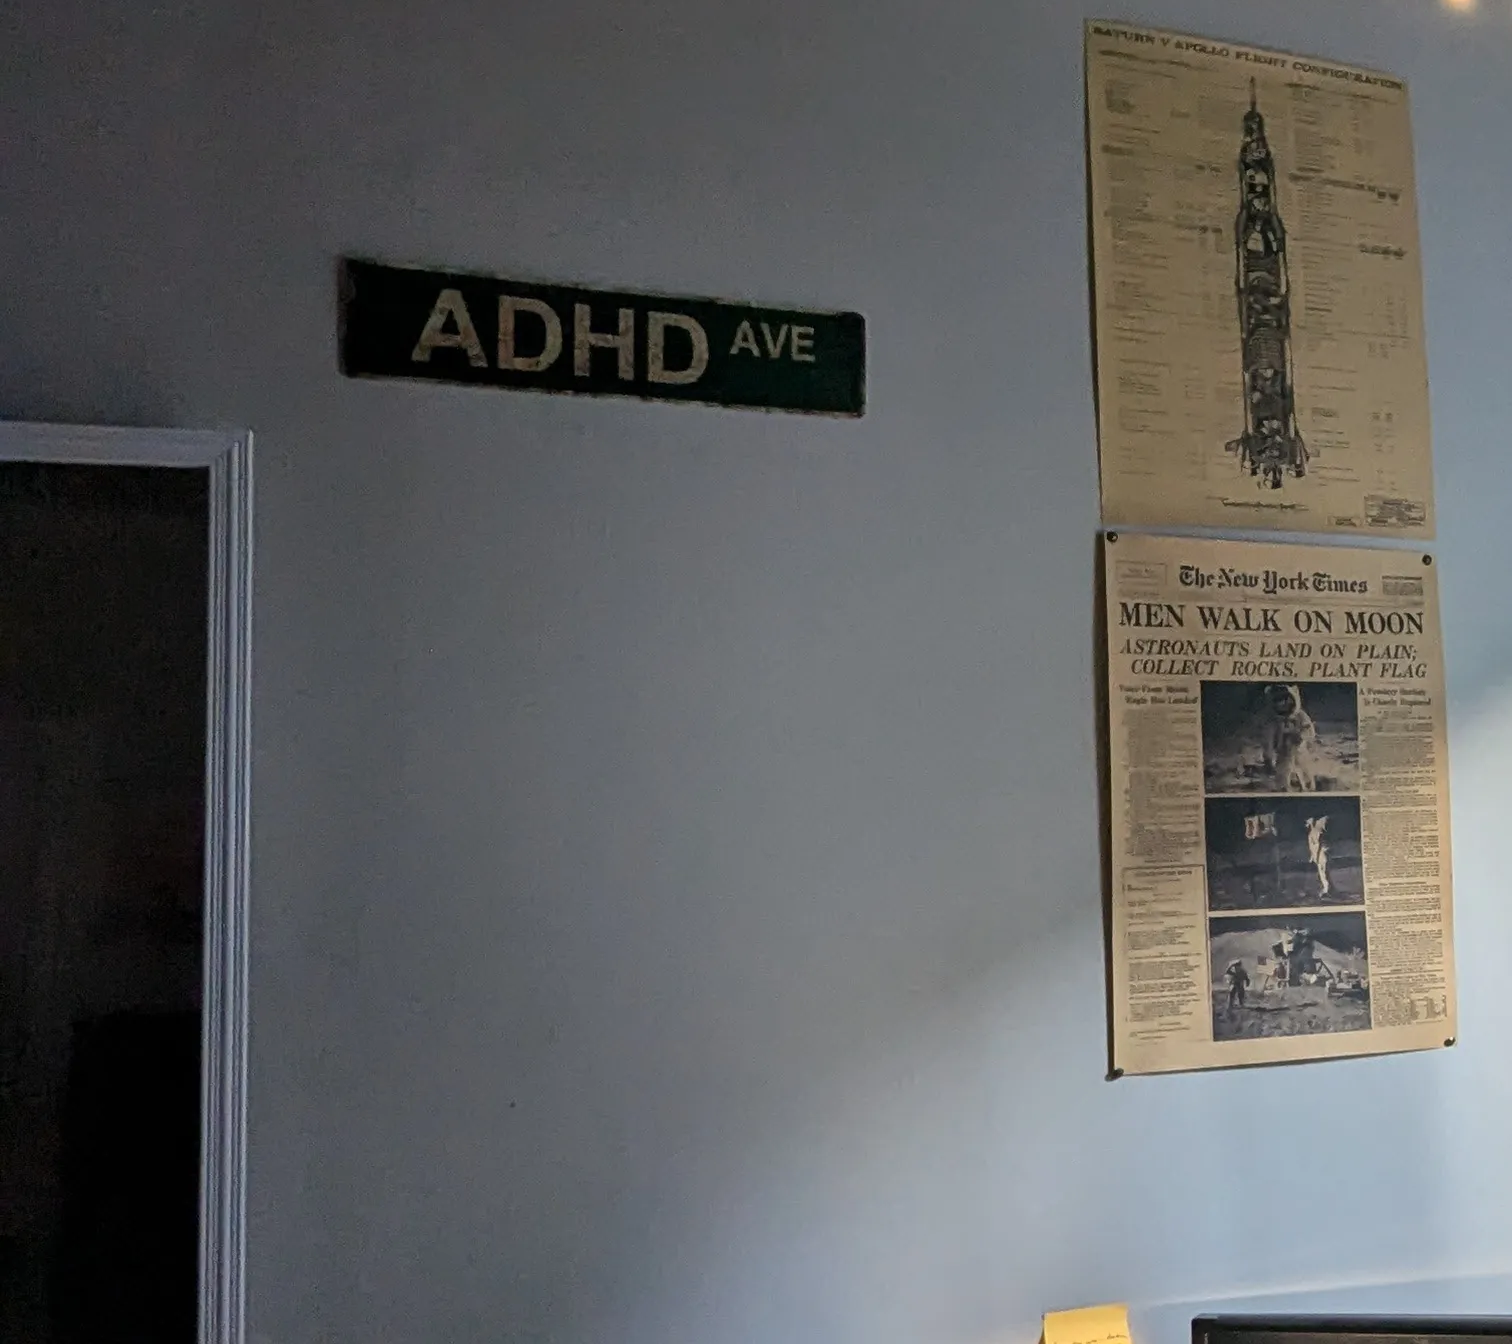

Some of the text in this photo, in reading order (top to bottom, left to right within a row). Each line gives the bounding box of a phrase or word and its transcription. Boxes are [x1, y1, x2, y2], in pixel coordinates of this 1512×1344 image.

[1174, 41, 1229, 57] APOLLO
[411, 288, 816, 385] ADHD AVE
[1179, 565, 1214, 589] The
[1217, 567, 1260, 589] New
[1262, 570, 1310, 594] York
[1312, 571, 1368, 594] Times
[1119, 602, 1424, 635] MEN WALK ON MOON
[1119, 638, 1418, 662] ASTRONAUTS LAND ON PLAIN;
[1130, 659, 1220, 676] COLLECT
[1309, 662, 1372, 678] PLANT
[1379, 662, 1427, 679] FLAG
